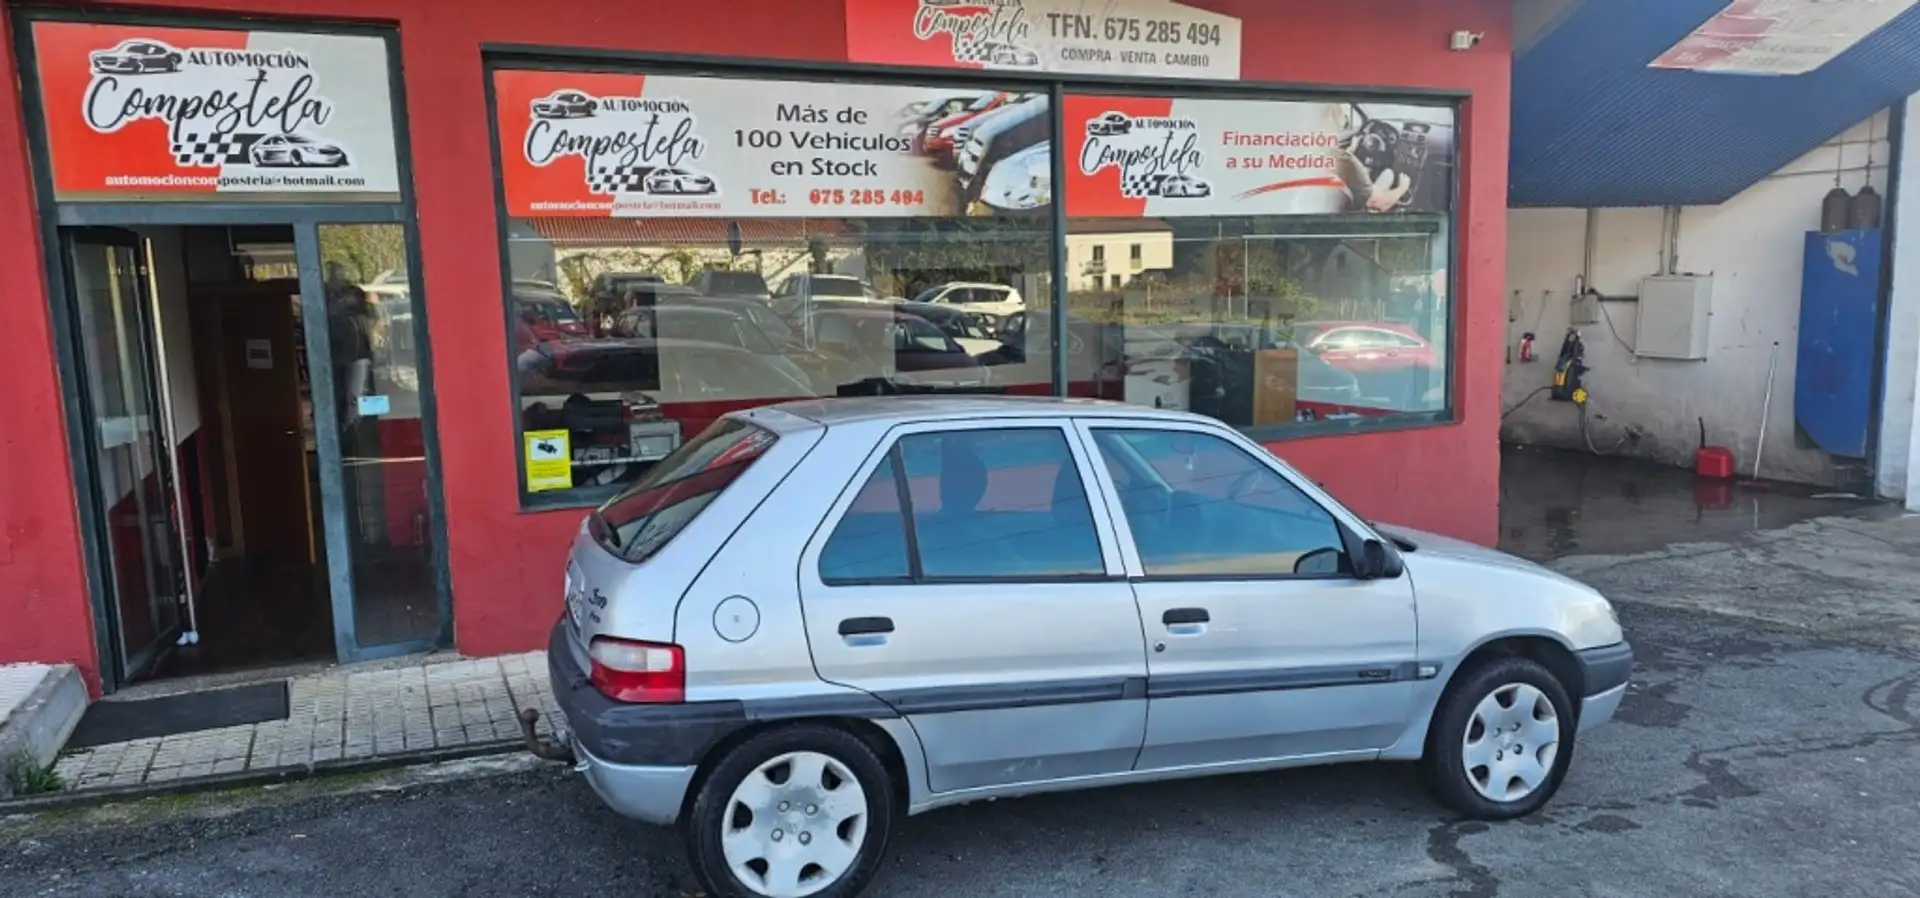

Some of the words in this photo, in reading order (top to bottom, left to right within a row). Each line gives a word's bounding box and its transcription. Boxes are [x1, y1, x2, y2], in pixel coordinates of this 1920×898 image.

[915, 4, 1029, 48] Compostela
[1047, 13, 1098, 40] TFN.
[1104, 17, 1140, 41] 675
[1146, 20, 1181, 44] 285
[1187, 23, 1221, 46] 494
[187, 50, 310, 69] AUTOMOCIÓN
[1061, 47, 1112, 62] COMPRA
[1120, 50, 1157, 64] VENTA
[1165, 53, 1209, 67] CAMBIO
[88, 69, 331, 143] Compostela
[776, 103, 828, 123] Más
[836, 107, 867, 124] de
[527, 114, 705, 181] Compostela
[735, 129, 782, 148] 100
[1222, 131, 1339, 147] Financiación
[770, 160, 803, 176] en
[811, 157, 877, 176] Stock
[1082, 130, 1204, 185] Compostela
[1226, 157, 1237, 168] a
[1242, 157, 1263, 168] su
[1268, 154, 1335, 169] Medida
[809, 188, 844, 204] 675
[849, 189, 885, 204] 285
[890, 189, 924, 204] 494
